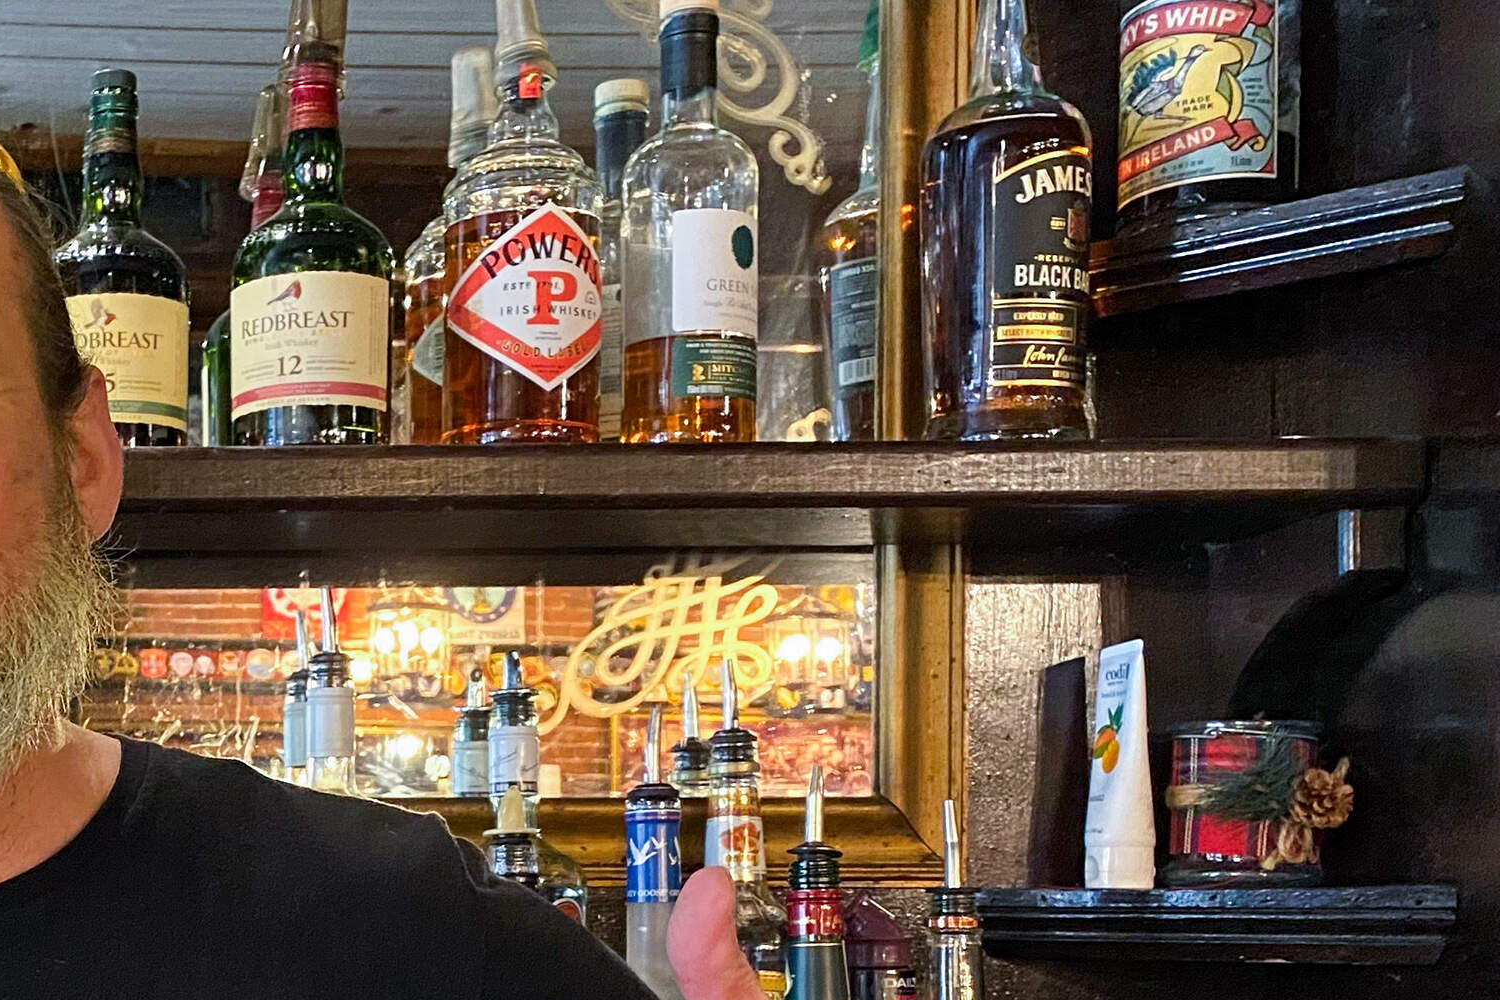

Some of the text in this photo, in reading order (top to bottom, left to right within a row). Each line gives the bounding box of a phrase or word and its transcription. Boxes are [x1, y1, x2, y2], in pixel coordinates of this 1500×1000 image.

[1165, 6, 1236, 29] WHIP
[1175, 94, 1212, 108] TRADE
[1182, 103, 1214, 114] MARK
[1135, 125, 1216, 169] IRELAND
[1015, 165, 1092, 204] JAMES
[480, 231, 599, 285] POWERS
[706, 277, 749, 294] GREEN
[1014, 263, 1071, 287] BLACK
[526, 270, 578, 325] P
[500, 304, 597, 320] IRISH WHISKEY
[241, 310, 355, 340] REDBREAST
[74, 331, 164, 350] DBREAST
[502, 340, 590, 358] GOLD LABEL
[277, 354, 303, 377] 12
[104, 372, 116, 393] 5
[637, 889, 668, 897] GOOSE
